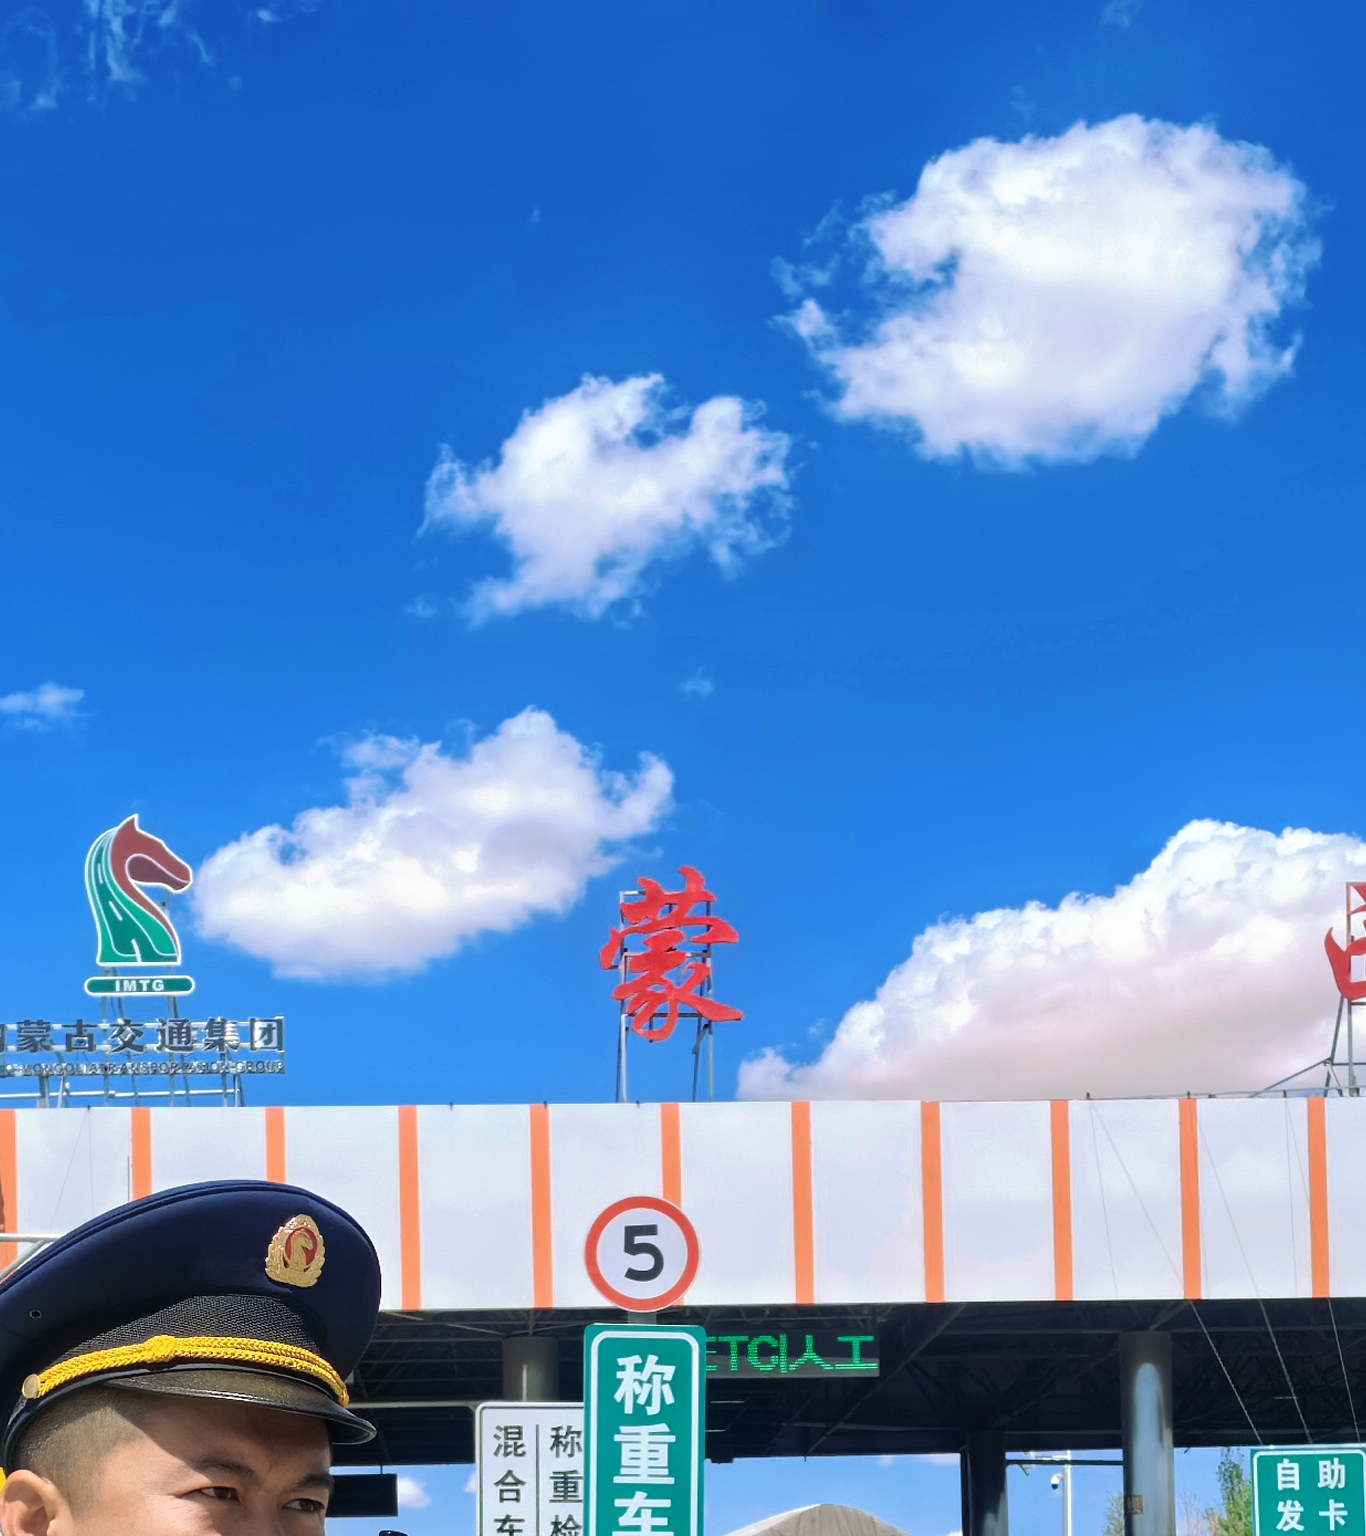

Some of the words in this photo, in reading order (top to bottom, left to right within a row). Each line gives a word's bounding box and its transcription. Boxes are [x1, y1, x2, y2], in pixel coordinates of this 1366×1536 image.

[114, 979, 166, 993] IMTG
[623, 1223, 665, 1283] 5
[1276, 1457, 1347, 1491] 自助
[1275, 1499, 1349, 1532] 发卡
